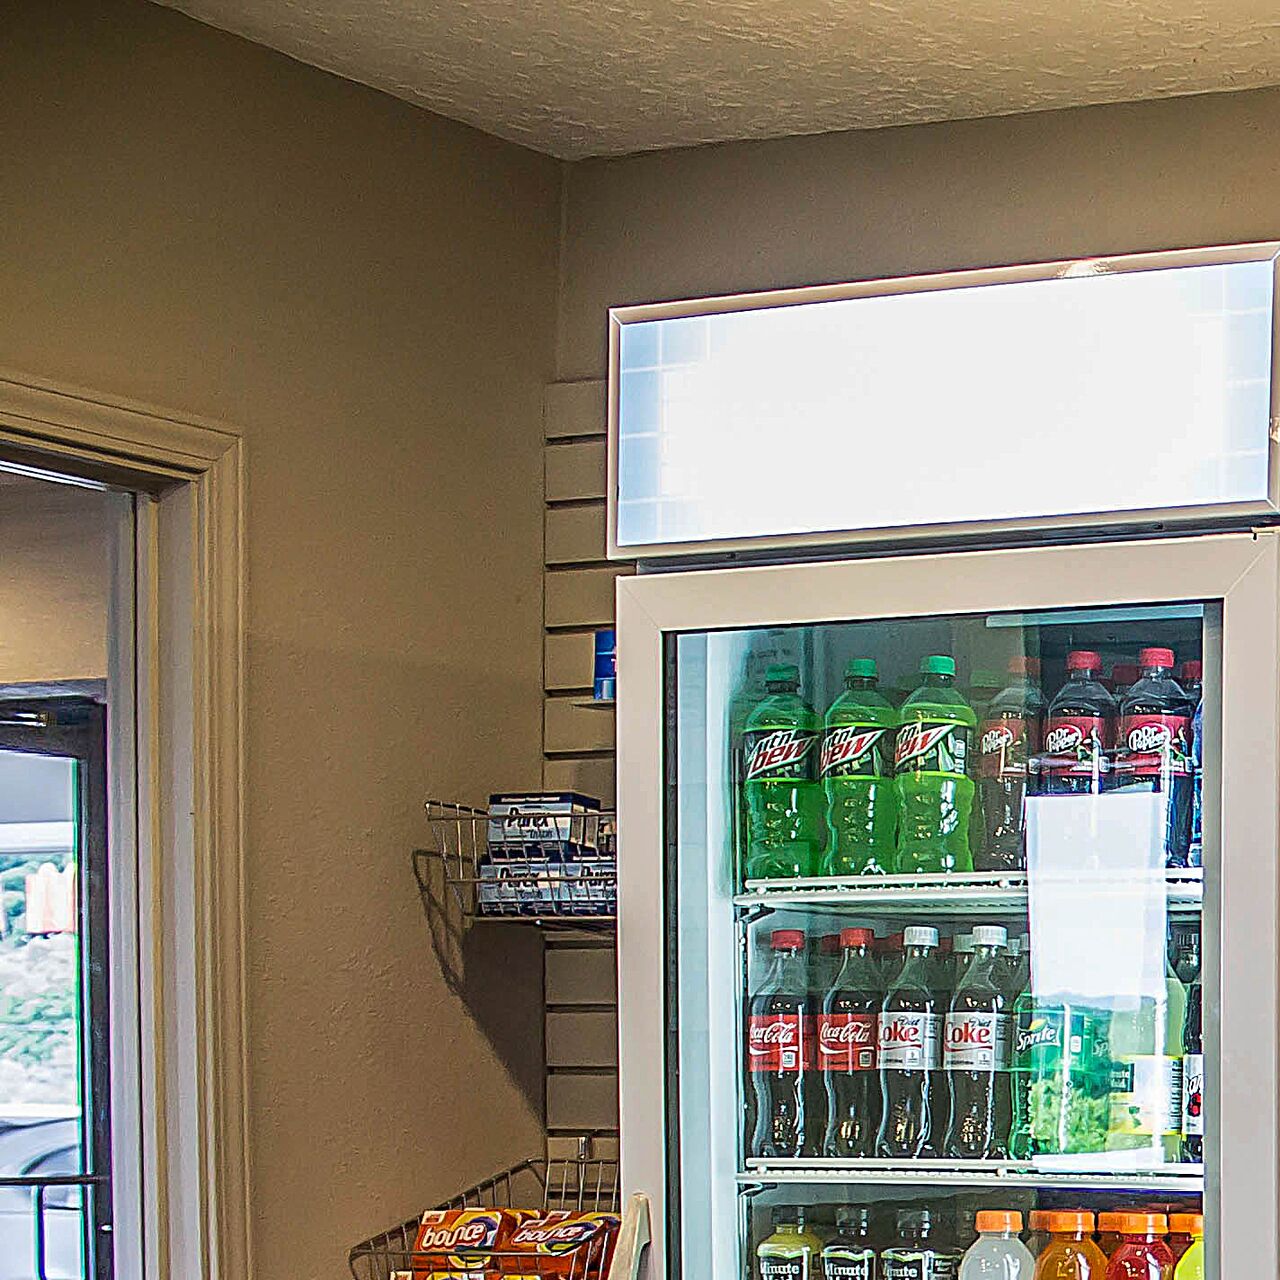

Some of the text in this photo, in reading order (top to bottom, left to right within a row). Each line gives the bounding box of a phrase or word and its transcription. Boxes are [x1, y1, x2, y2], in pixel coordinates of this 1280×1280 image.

[1017, 1027, 1061, 1052] Sprite
[422, 1222, 486, 1248] bounce
[514, 1224, 585, 1244] bounce
